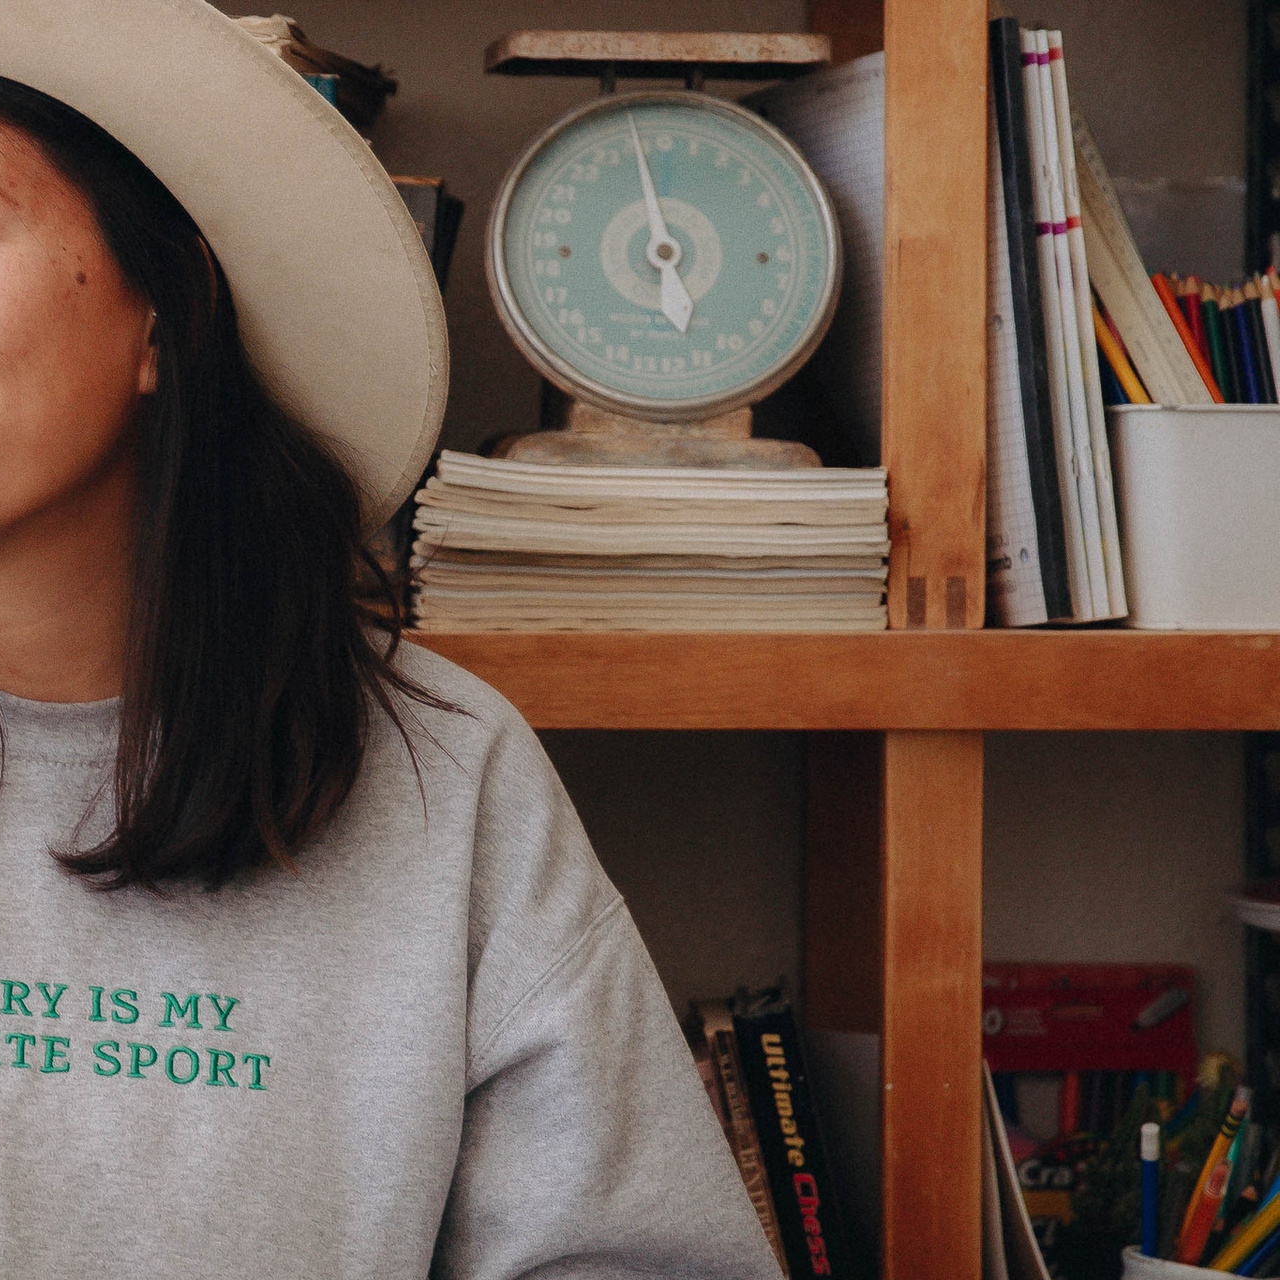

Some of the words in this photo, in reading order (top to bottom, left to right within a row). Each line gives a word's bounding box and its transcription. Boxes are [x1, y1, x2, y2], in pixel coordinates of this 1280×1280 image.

[88, 985, 140, 1025] IS
[160, 991, 241, 1032] MY
[92, 1039, 272, 1091] SPORT
[760, 1032, 806, 1168] Ultimate
[793, 1171, 832, 1276] Chess
